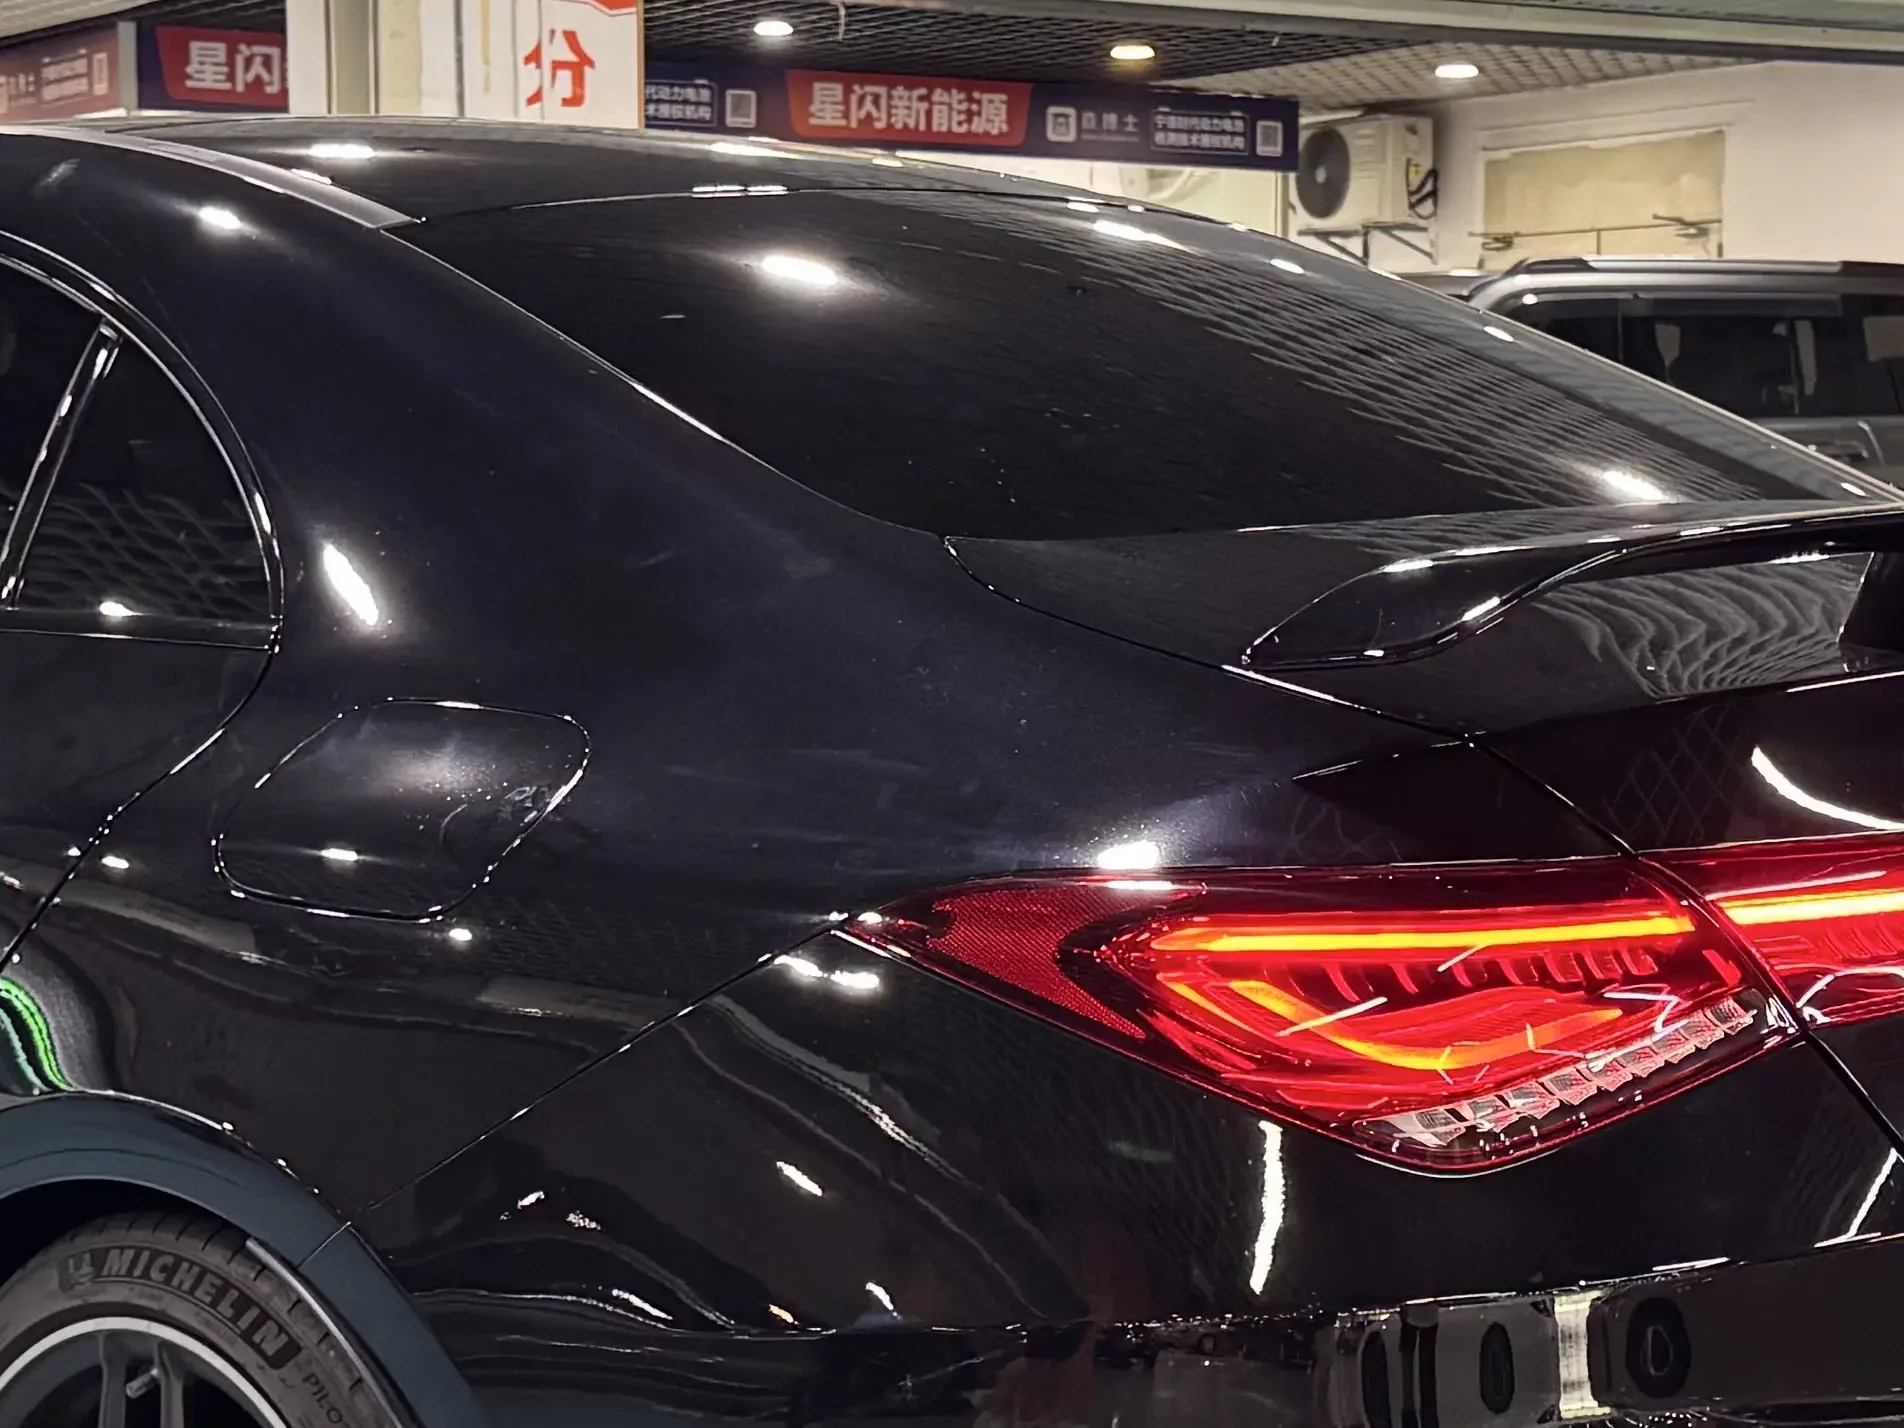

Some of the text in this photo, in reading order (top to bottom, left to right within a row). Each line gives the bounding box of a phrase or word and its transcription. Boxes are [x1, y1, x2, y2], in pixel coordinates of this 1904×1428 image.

[184, 40, 288, 95] 星闪
[523, 28, 596, 108] 分
[808, 81, 1010, 135] 星闪新能源
[100, 1248, 290, 1356] MICHELIN
